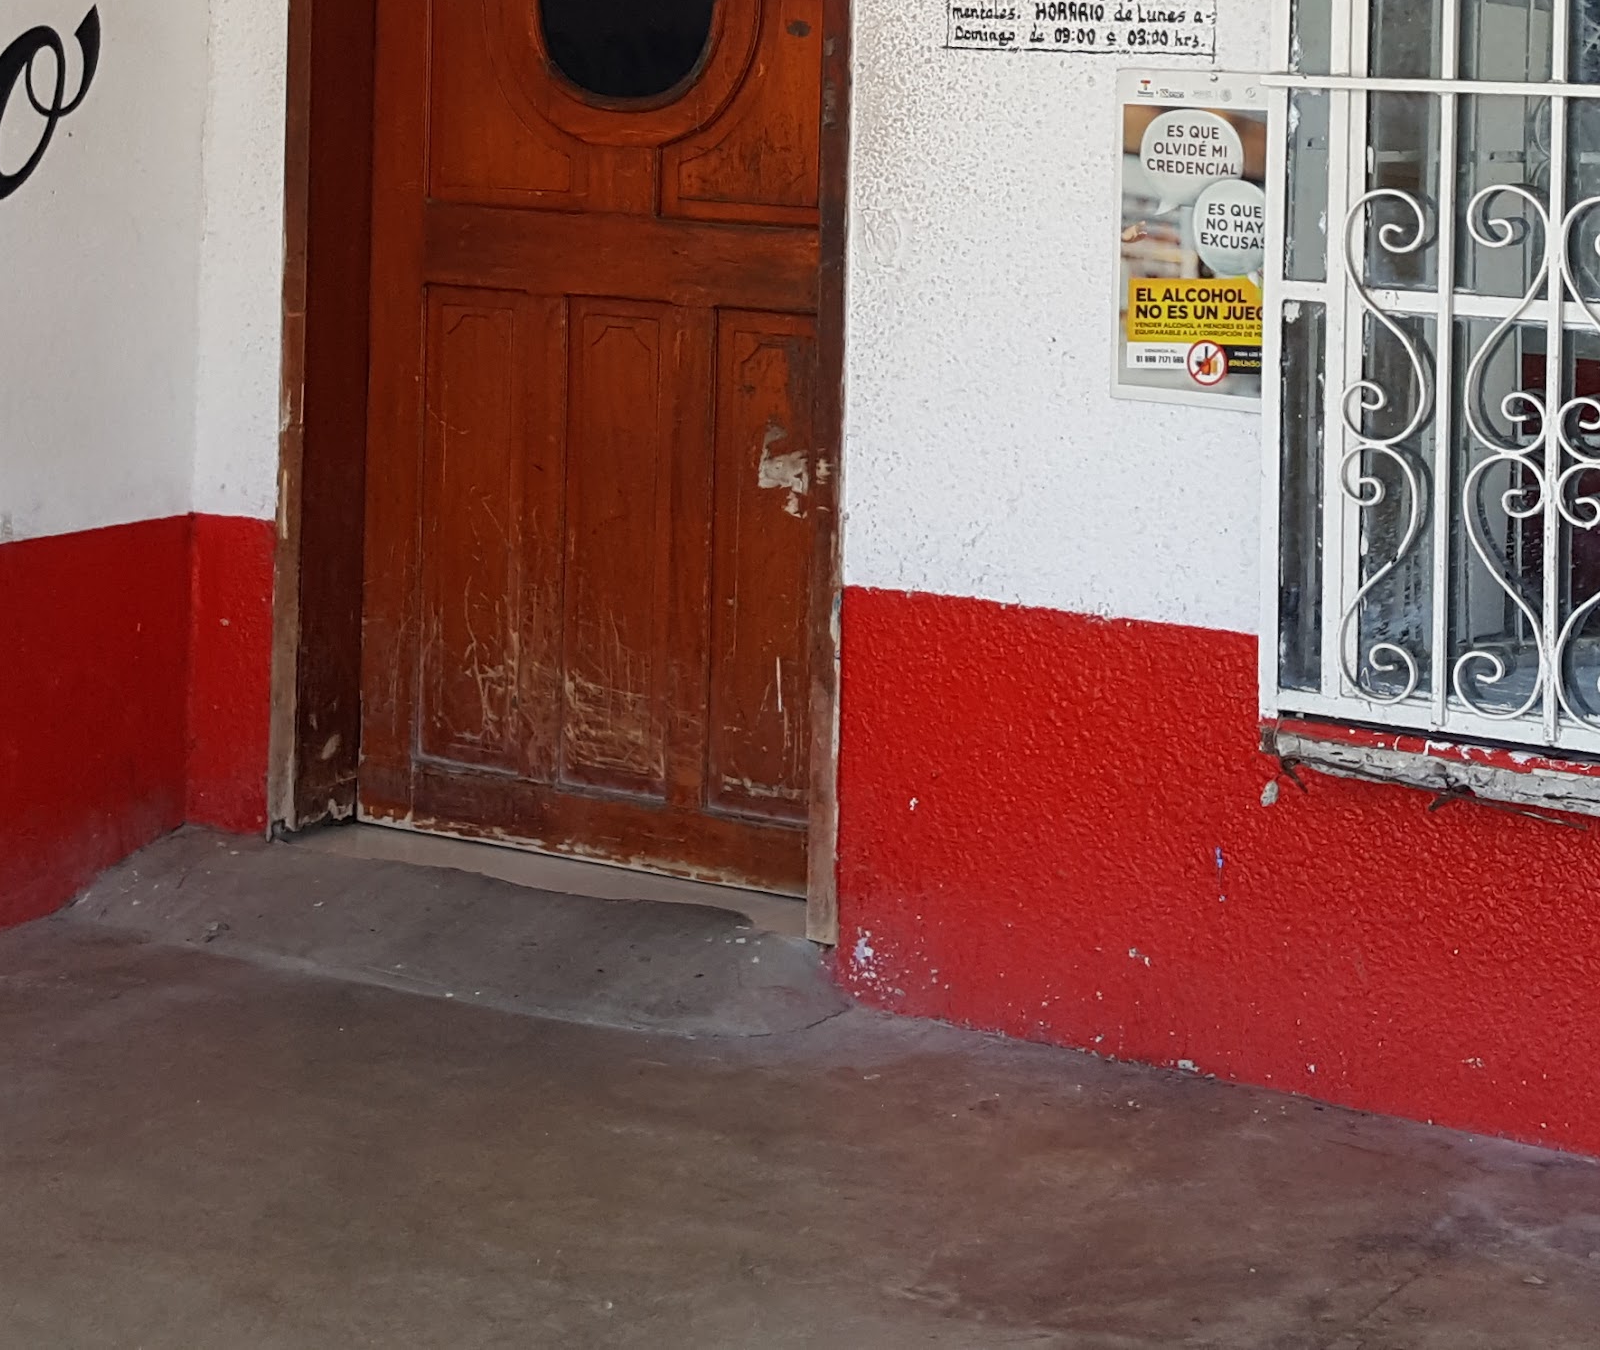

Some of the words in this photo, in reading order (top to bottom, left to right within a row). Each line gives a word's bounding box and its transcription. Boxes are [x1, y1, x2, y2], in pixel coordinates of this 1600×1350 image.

[1035, 1, 1105, 22] HORARIO
[1137, 2, 1186, 24] Lunes
[954, 25, 1016, 47] Domingo
[1054, 27, 1096, 46] 09:00
[1166, 124, 1184, 138] ES
[1189, 125, 1220, 140] QUE
[1153, 140, 1207, 157] OLVIDÉ
[1211, 145, 1228, 158] MI
[1146, 158, 1238, 176] CREDENCIAL
[1208, 203, 1226, 216] ES
[1230, 204, 1263, 219] QUE
[1206, 218, 1229, 232] NO
[1233, 220, 1264, 234] HAY
[1135, 288, 1157, 302] EL
[1161, 288, 1247, 304] ALCOHOL
[1135, 305, 1162, 319] NO
[1167, 305, 1188, 319] ES
[1193, 306, 1218, 320] UN
